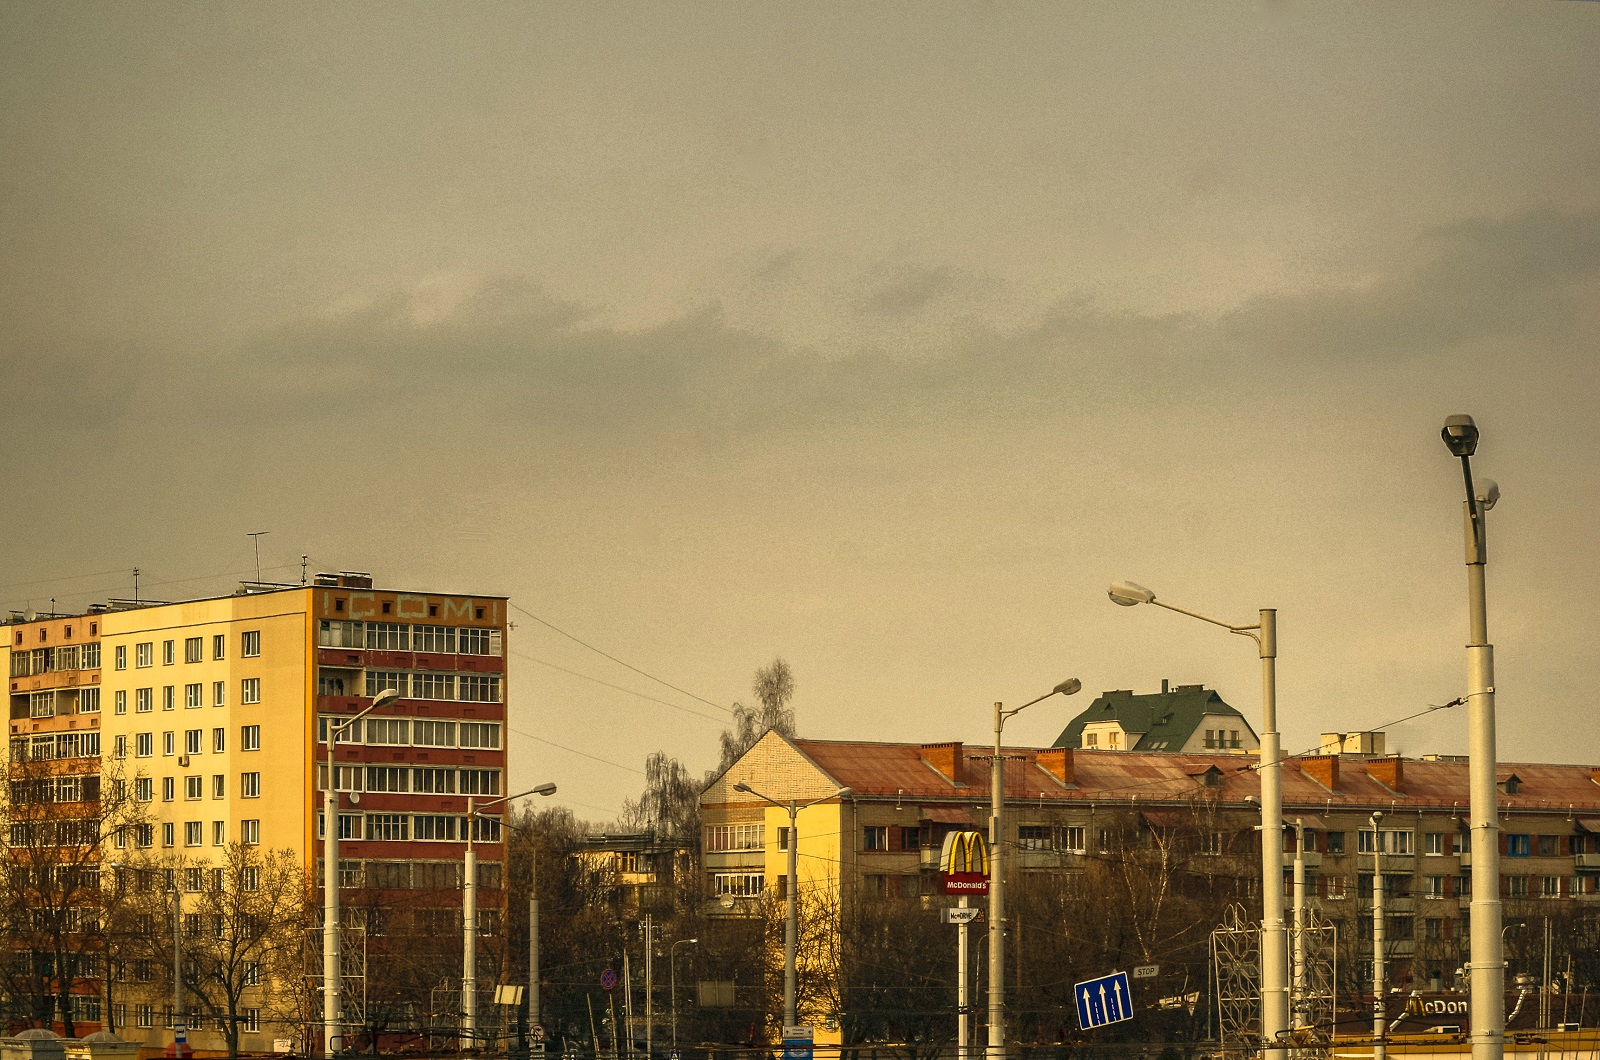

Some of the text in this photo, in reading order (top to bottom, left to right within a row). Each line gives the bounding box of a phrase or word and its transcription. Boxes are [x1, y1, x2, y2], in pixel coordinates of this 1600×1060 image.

[947, 881, 987, 889] McDonald's
[1137, 967, 1155, 976] STOP
[1405, 996, 1468, 1016] McDon
